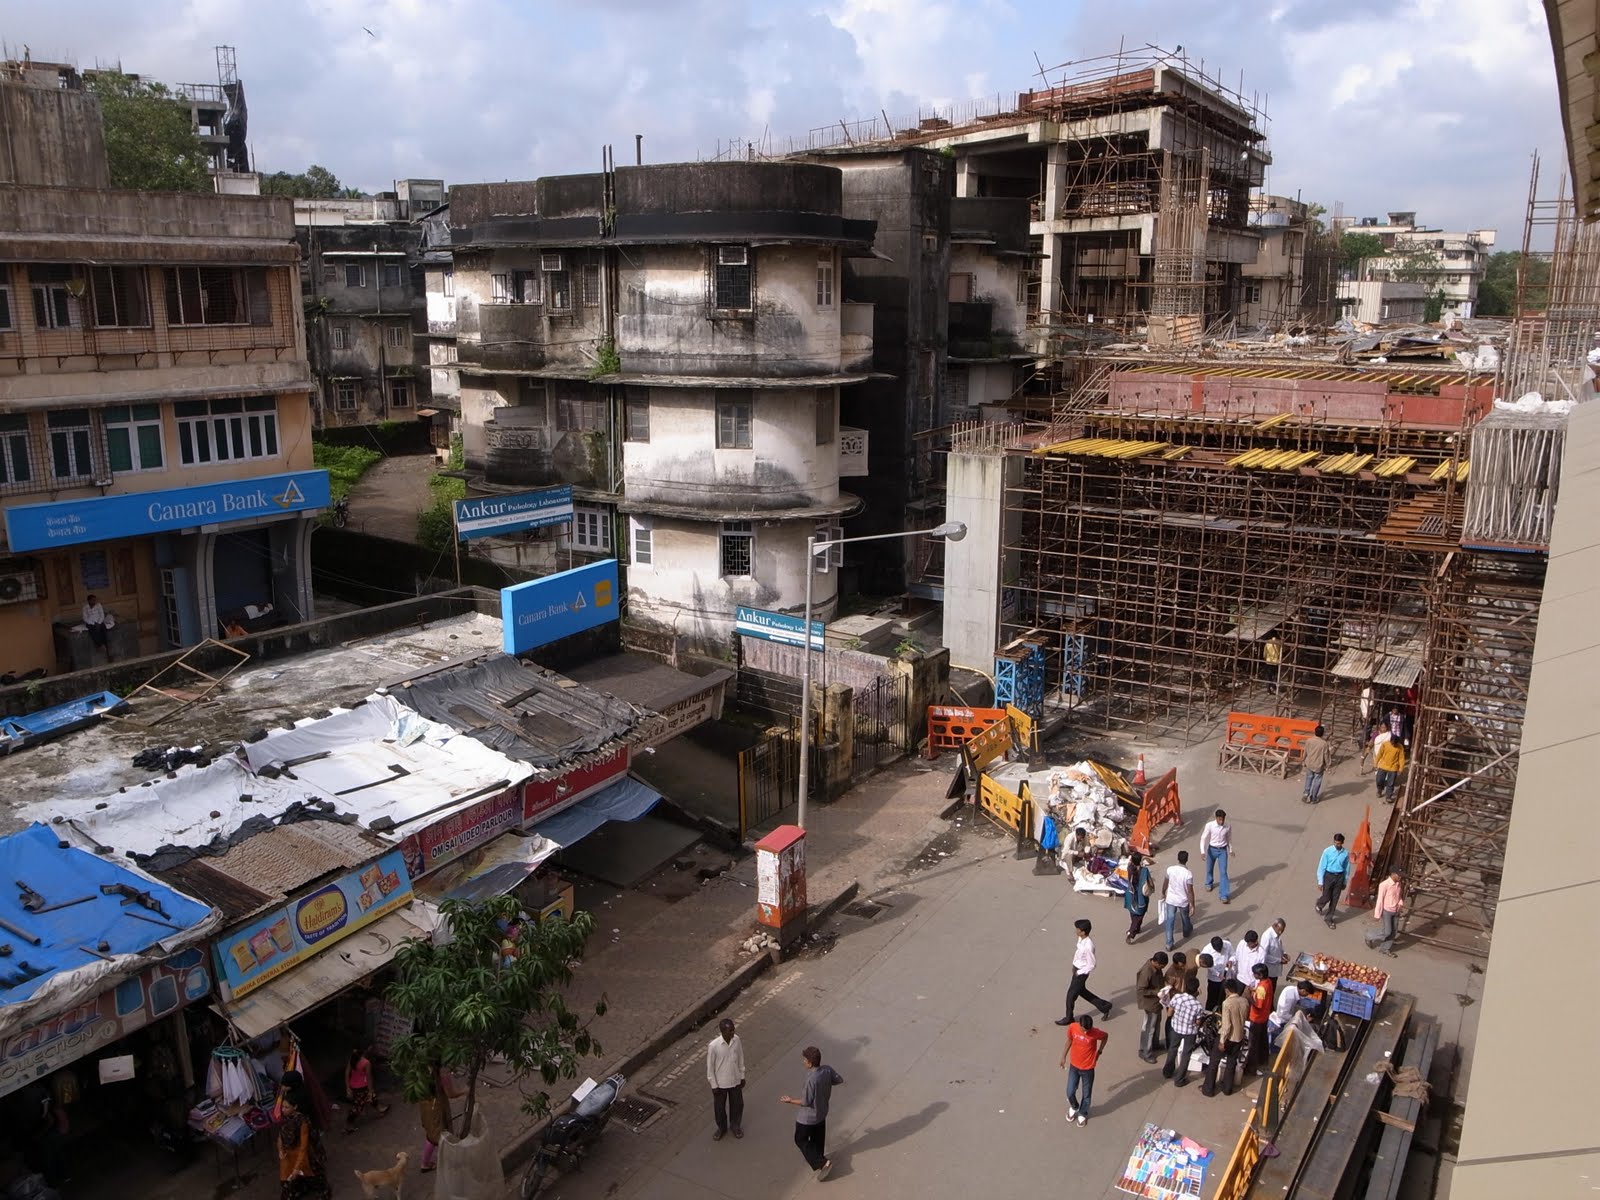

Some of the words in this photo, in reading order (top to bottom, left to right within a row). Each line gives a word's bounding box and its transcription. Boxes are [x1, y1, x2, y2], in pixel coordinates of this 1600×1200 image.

[148, 499, 217, 522] Canara
[222, 489, 268, 512] Bank
[460, 500, 507, 520] Ankur
[518, 610, 547, 626] Canara
[548, 601, 568, 617] Bank
[738, 609, 772, 625] Ankur
[1260, 723, 1281, 733] SEW
[431, 845, 444, 859] OM
[444, 838, 457, 851] SAI
[459, 825, 480, 845] VIDEO
[480, 808, 513, 833] PARLOUR
[304, 902, 342, 930] Haldiram's
[256, 968, 280, 984] GENERAL
[0, 1026, 94, 1081] OLLECTION
